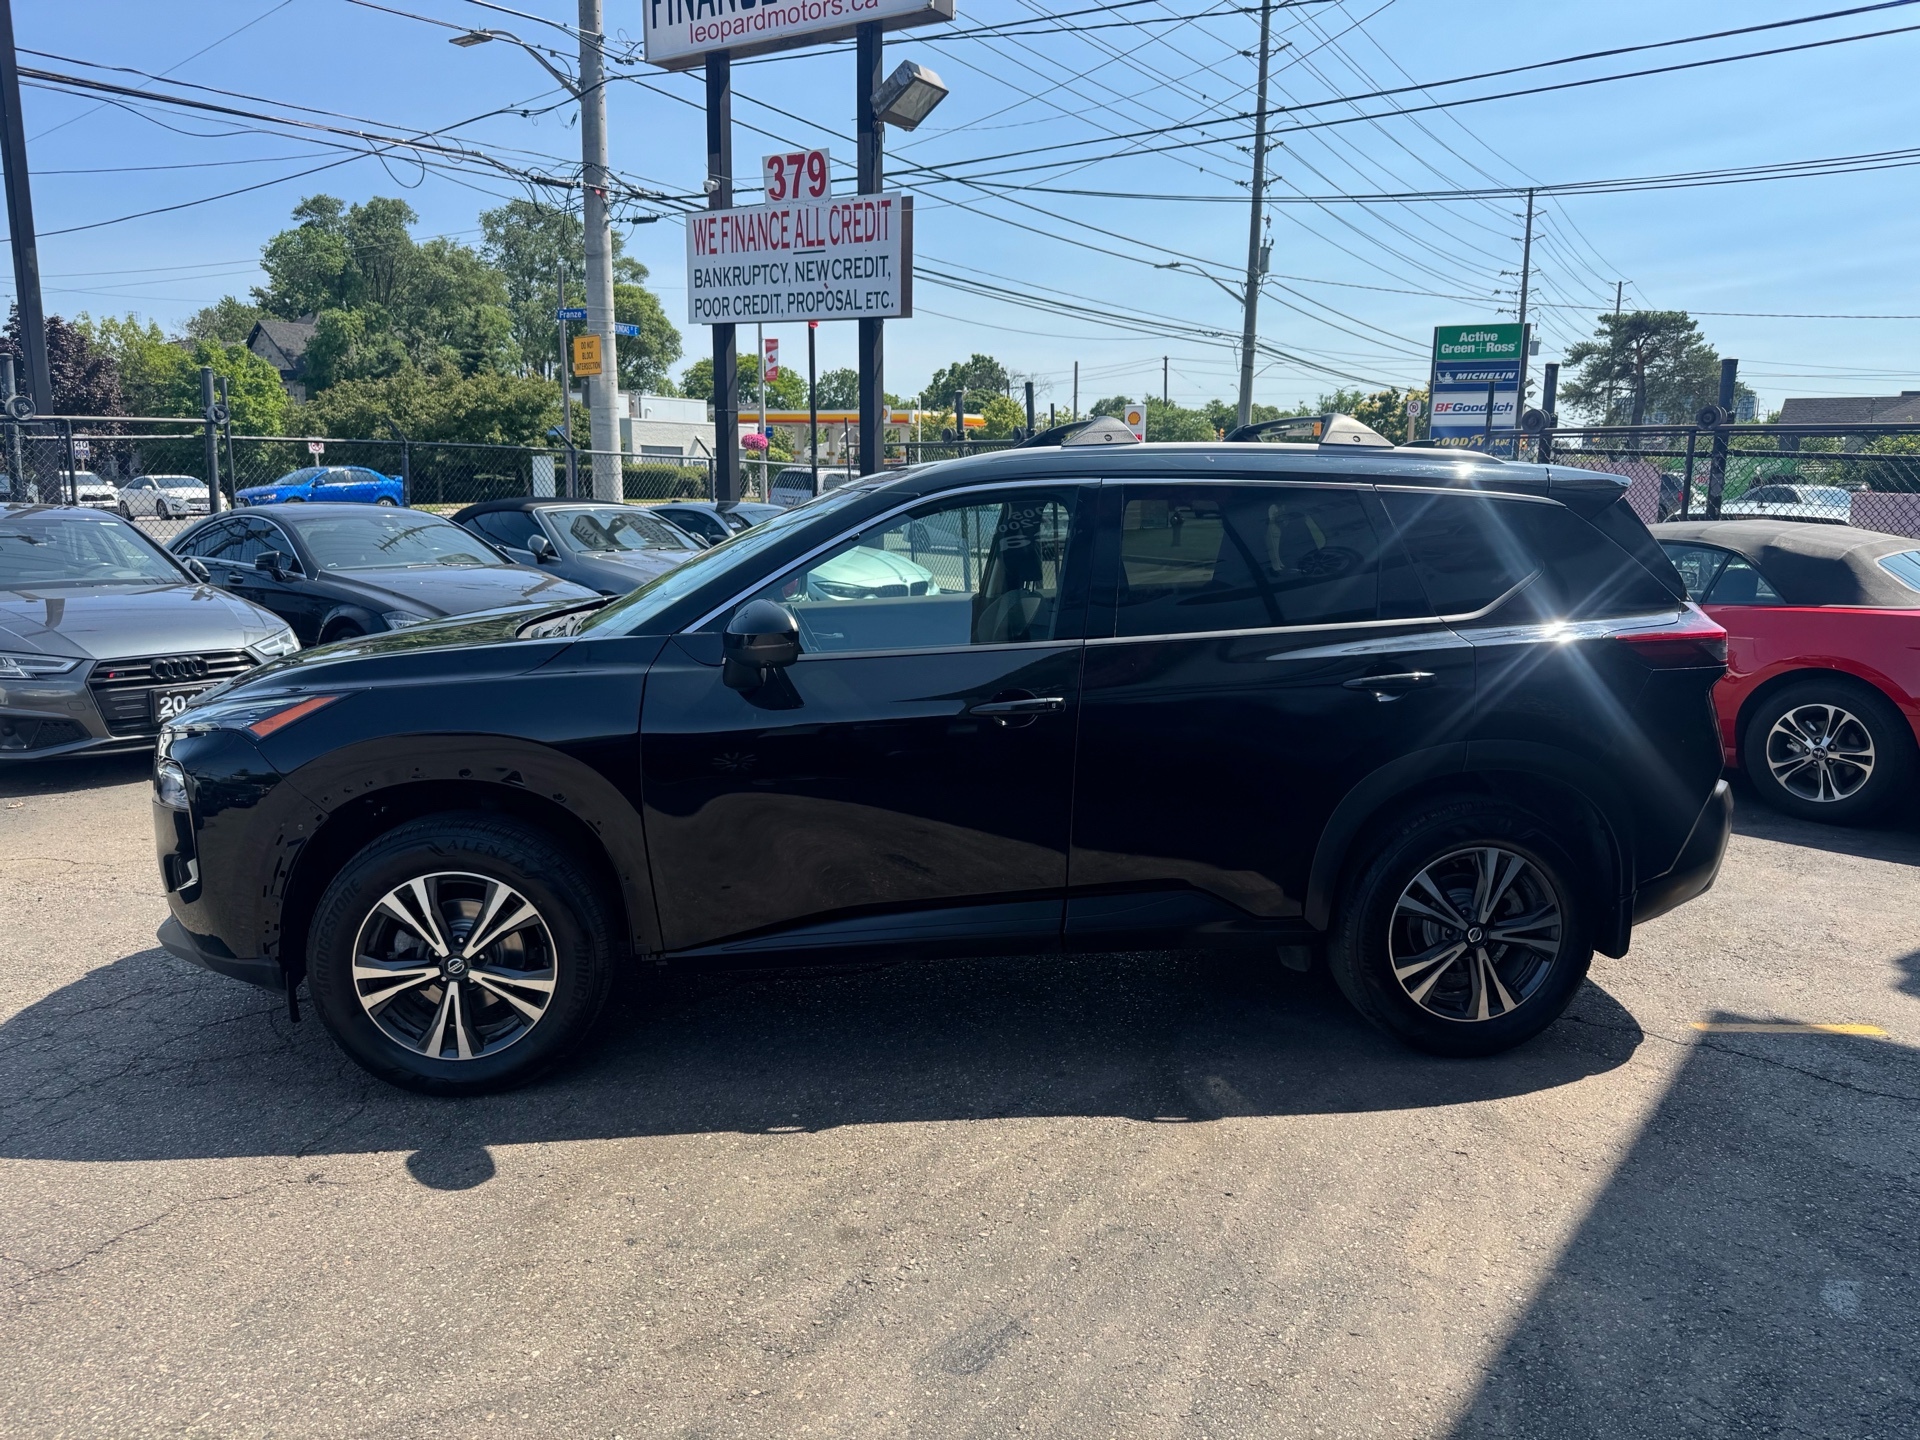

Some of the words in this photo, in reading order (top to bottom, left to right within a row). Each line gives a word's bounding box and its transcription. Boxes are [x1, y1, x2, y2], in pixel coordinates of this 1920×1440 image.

[689, 0, 878, 44] leopardmotors.ca
[767, 151, 827, 201] 379
[693, 217, 718, 256] WE
[721, 210, 790, 254] FINANCE
[794, 207, 825, 248] ALL
[829, 199, 892, 246] CREDIT
[694, 262, 791, 288] BANKRUPTCY,
[795, 259, 830, 282] NEW
[831, 255, 891, 281] CREDIT,
[695, 297, 730, 318] POOR
[733, 293, 784, 317] CREDIT,
[787, 289, 862, 313] PROPOSAL
[866, 291, 894, 309] ETC.
[559, 310, 582, 319] Franze
[1458, 331, 1498, 342] Active
[581, 341, 586, 350] DO
[582, 351, 594, 360] BLOCK
[576, 362, 601, 370] INTERSECTION
[1455, 372, 1516, 380] MICHELIN
[1434, 402, 1514, 412] BFGoodich
[75, 441, 88, 449] 40
[159, 694, 196, 715] 20
[447, 839, 526, 870] ALENZA
